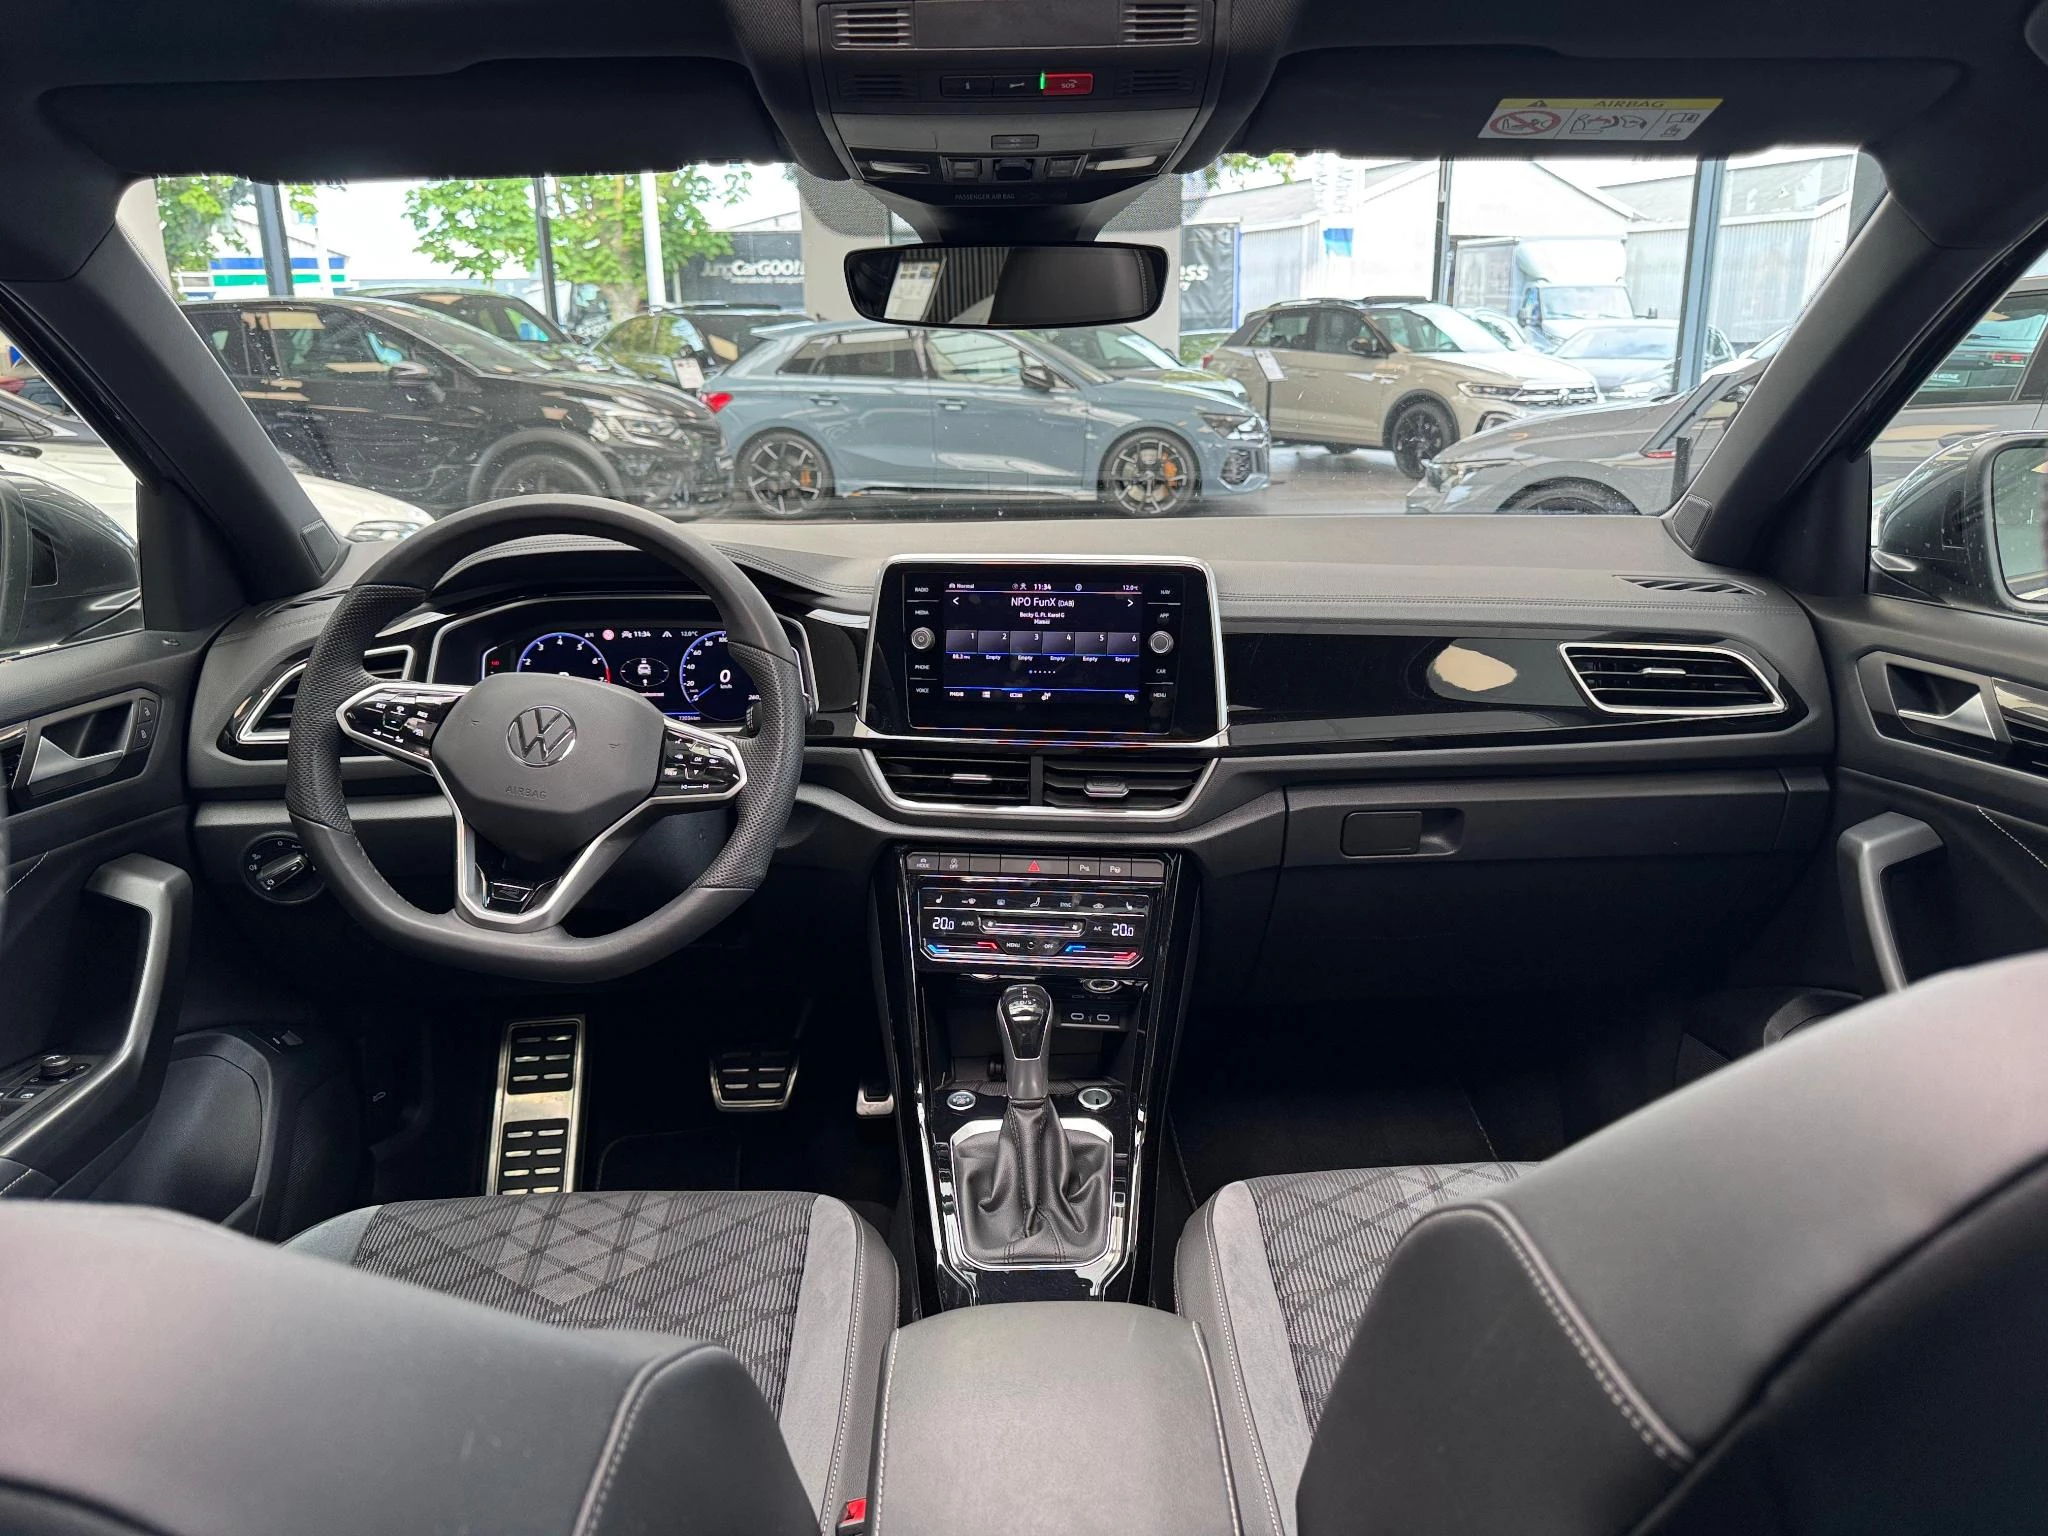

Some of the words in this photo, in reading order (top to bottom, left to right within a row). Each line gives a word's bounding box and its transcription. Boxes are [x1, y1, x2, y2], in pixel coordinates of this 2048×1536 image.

[1034, 583, 1052, 591] 11:34
[1011, 597, 1031, 607] NPO
[1033, 597, 1056, 607] FunX
[1058, 600, 1075, 608] (DAB)
[1034, 633, 1039, 641] 3
[1066, 633, 1071, 641] 4
[1131, 634, 1136, 642] 6
[577, 643, 583, 651] 5
[592, 657, 598, 665] 6
[719, 669, 731, 683] 0
[505, 785, 548, 799] AIRBAG
[932, 916, 955, 930] 20.0
[1111, 923, 1134, 937] 20.0
